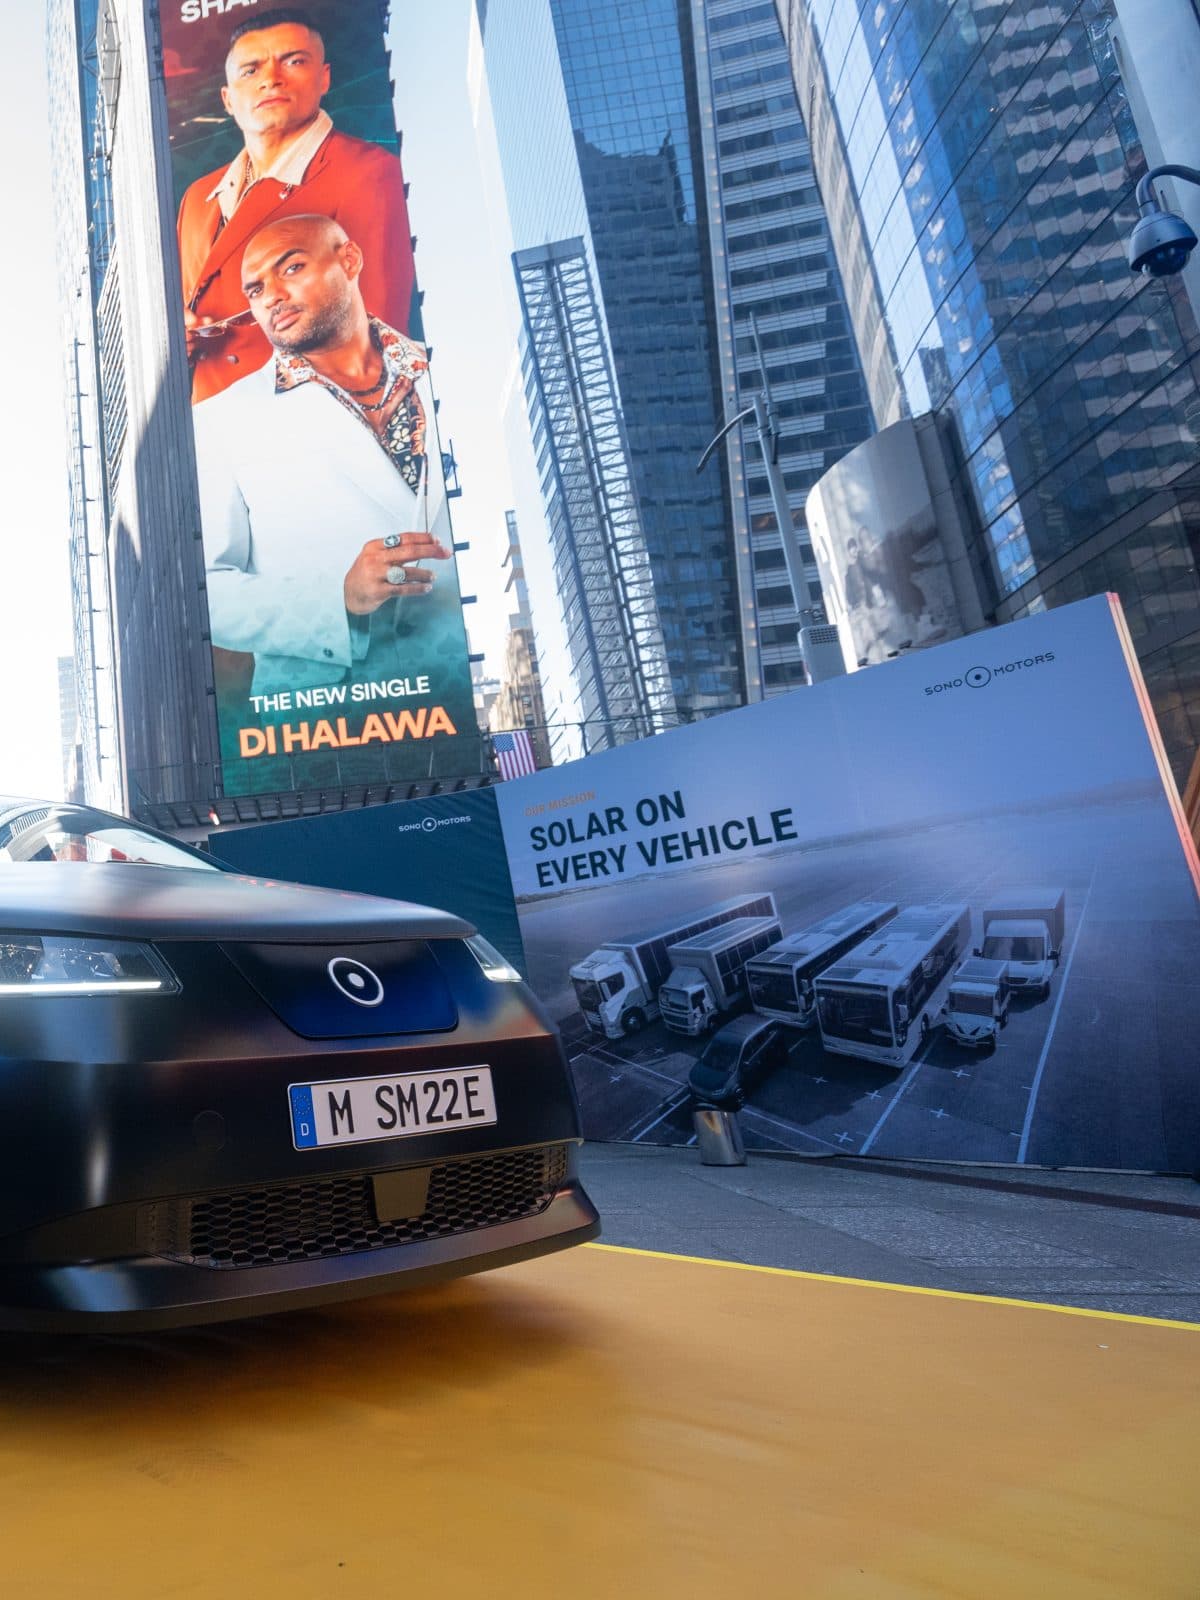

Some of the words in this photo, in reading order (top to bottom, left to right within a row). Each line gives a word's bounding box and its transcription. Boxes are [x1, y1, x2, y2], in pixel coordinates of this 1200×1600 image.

[181, 0, 258, 23] SH
[249, 692, 292, 714] THE
[296, 686, 347, 708] NEW
[351, 675, 431, 702] SINGLE
[924, 678, 963, 696] SONO
[993, 652, 1056, 676] MOTORS
[239, 725, 277, 758] DI
[281, 706, 458, 753] HALAWA
[398, 822, 421, 832] SONO
[437, 815, 472, 827] MOTORS
[524, 804, 545, 817] OUR
[548, 790, 596, 811] MISSION
[529, 806, 628, 852] SOLAR
[635, 790, 686, 827] ON
[535, 845, 627, 889] EVERY
[636, 807, 799, 868] VEHICLE
[300, 1122, 310, 1137] D
[328, 1089, 355, 1136] M
[375, 1075, 486, 1130] SM22E
